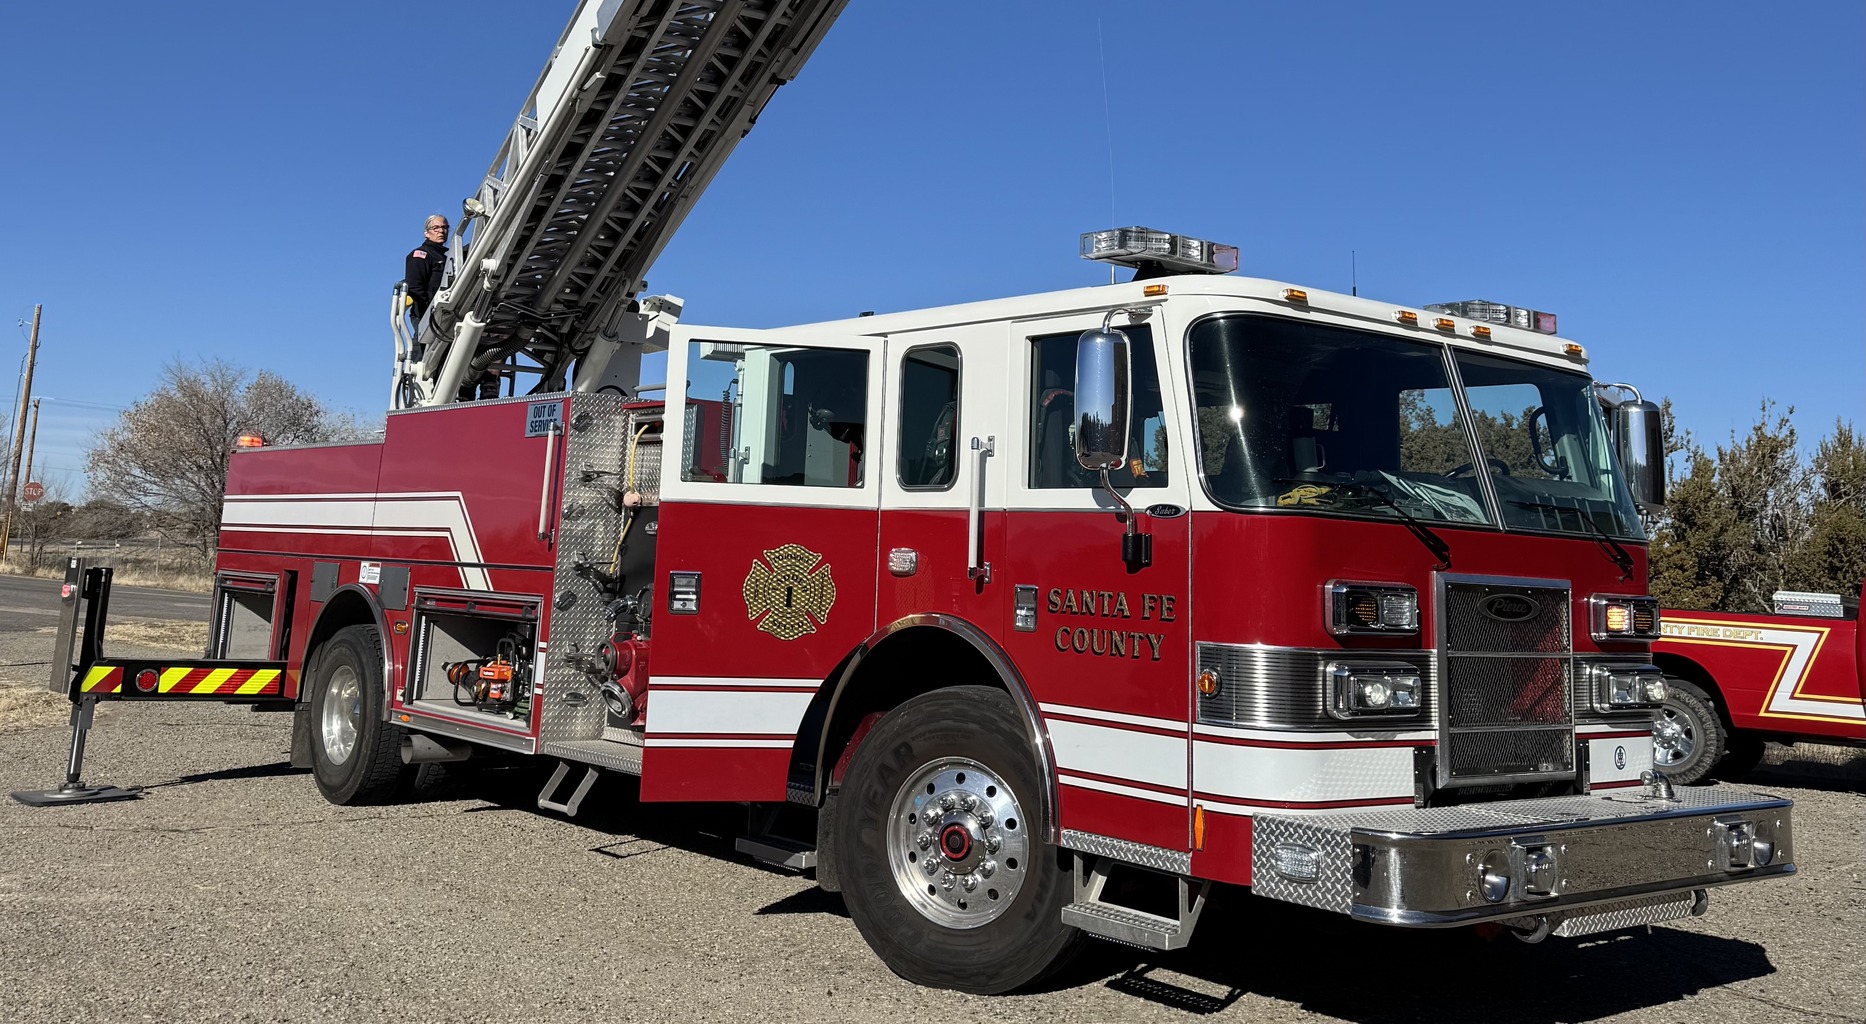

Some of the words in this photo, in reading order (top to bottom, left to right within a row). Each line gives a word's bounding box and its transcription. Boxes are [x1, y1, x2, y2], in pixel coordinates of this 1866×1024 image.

[533, 405, 546, 418] OUT
[547, 404, 556, 417] OF
[24, 487, 43, 496] STOP
[1048, 587, 1131, 619] SANTA
[1141, 592, 1176, 622] FE
[1491, 597, 1528, 614] Pierce
[1687, 626, 1721, 638] FIRE
[1722, 628, 1764, 641] DEPT.
[1054, 626, 1165, 661] COUNTY
